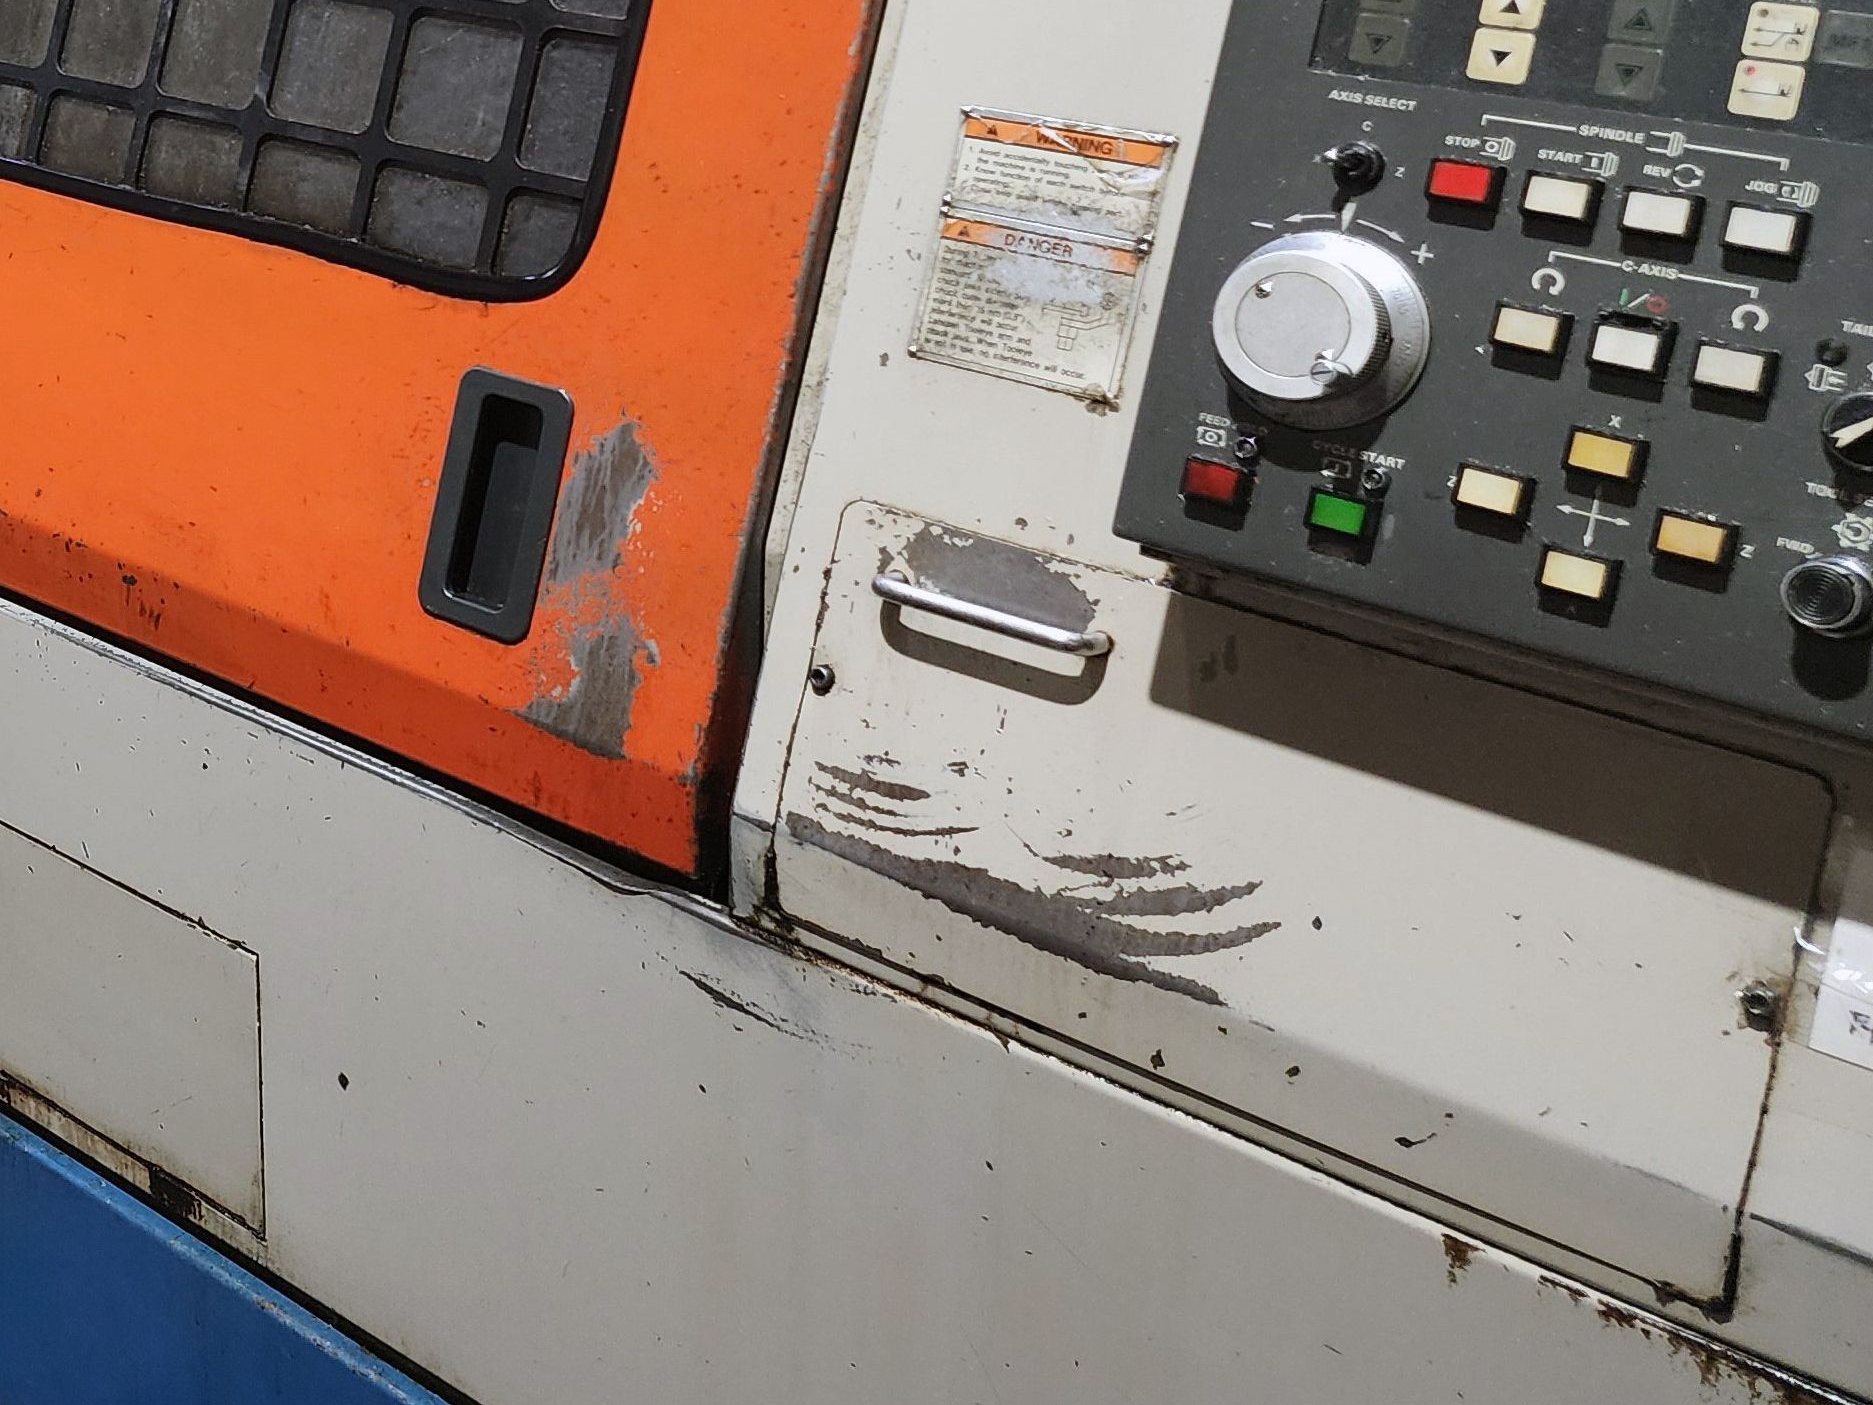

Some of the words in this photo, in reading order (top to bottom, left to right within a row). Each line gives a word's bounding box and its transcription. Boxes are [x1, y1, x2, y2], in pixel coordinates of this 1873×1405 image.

[1328, 88, 1363, 104] AXIS
[1364, 94, 1419, 112] SELECT
[1361, 120, 1375, 132] C
[1444, 134, 1480, 148] STOP
[1578, 124, 1646, 145] SPINDLE
[1537, 148, 1584, 165] START
[992, 159, 1026, 172] machine
[1394, 166, 1406, 178] Z
[1642, 164, 1672, 179] REV
[1744, 180, 1778, 196] JOG
[1003, 233, 1074, 258] DANGER
[1620, 259, 1678, 281] C-AXIS
[1044, 363, 1059, 374] will
[1197, 411, 1232, 429] FEED
[1608, 413, 1623, 428] X
[1358, 450, 1406, 472] START
[1738, 543, 1756, 558] Z
